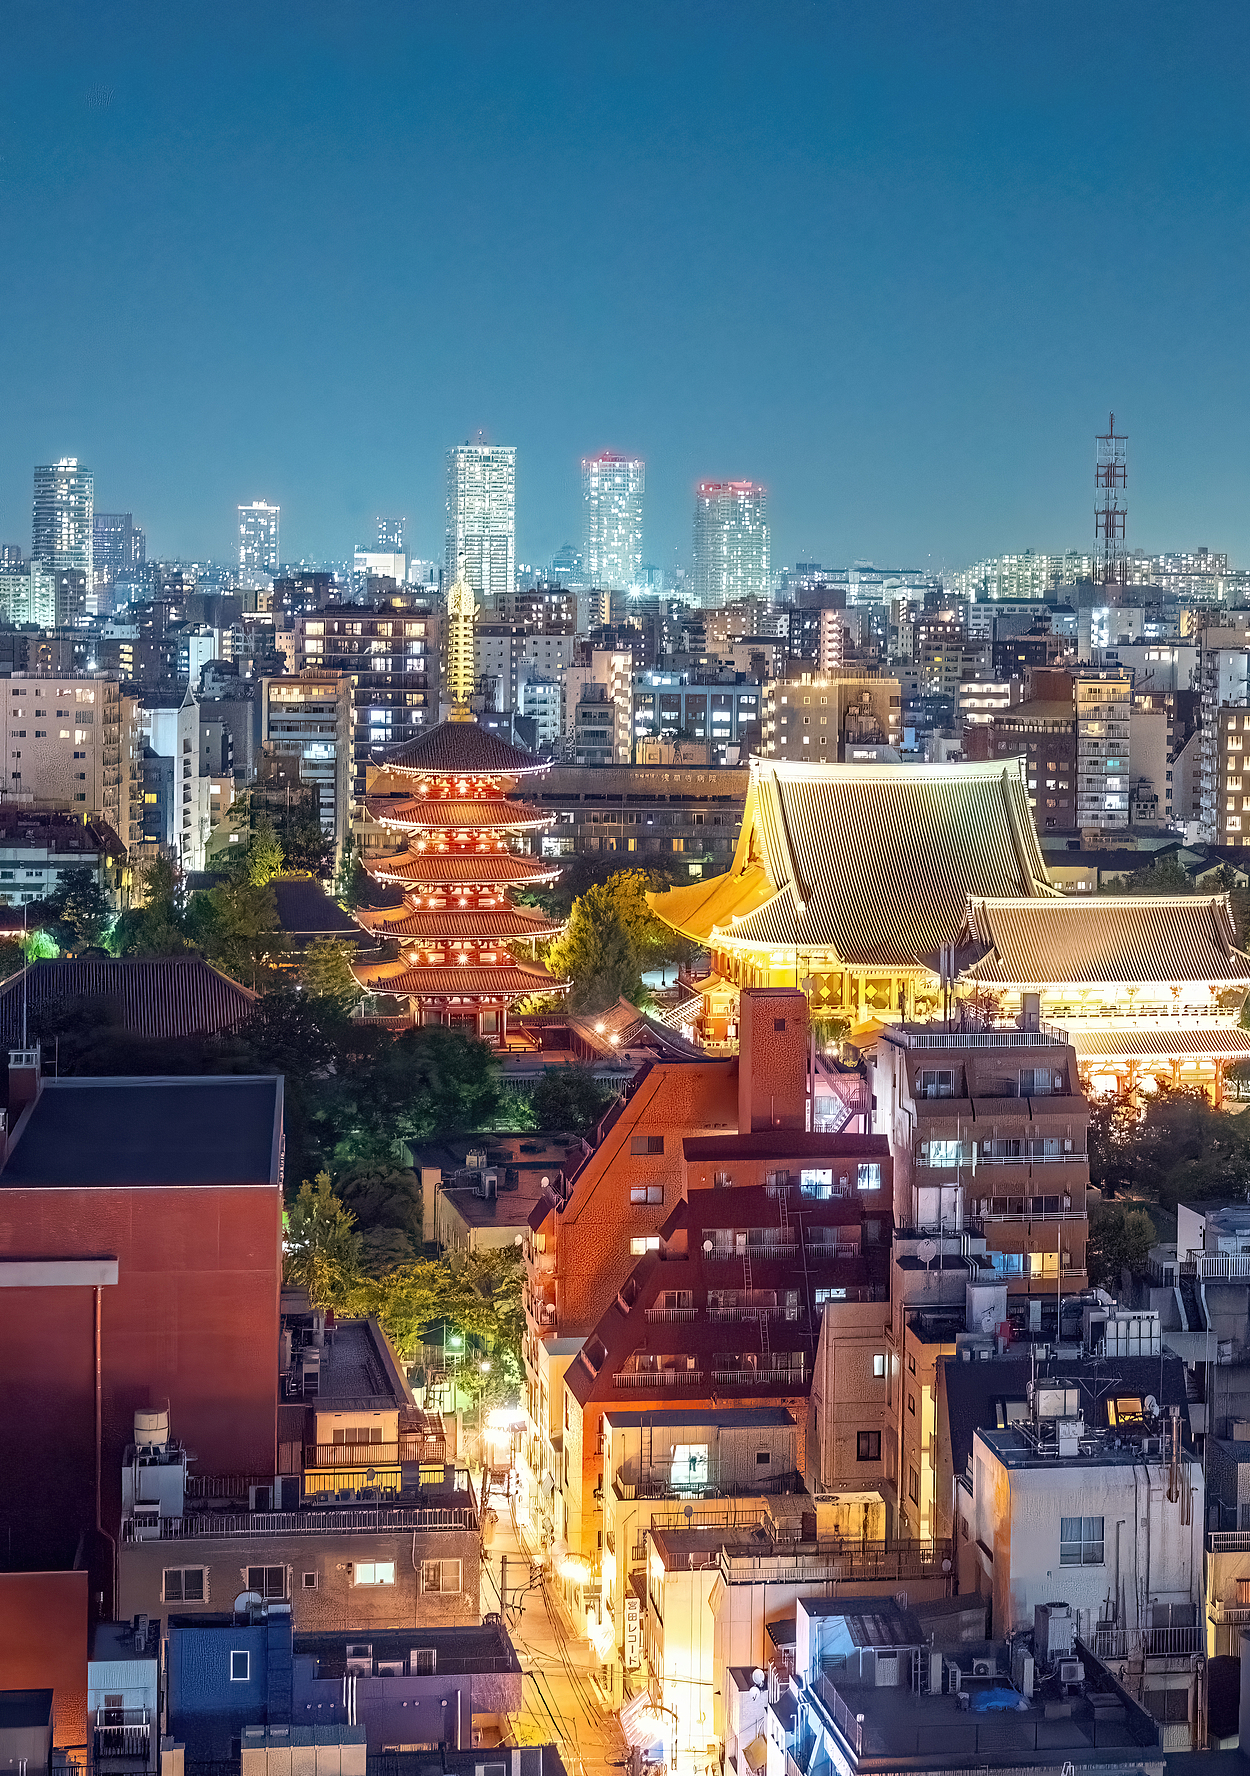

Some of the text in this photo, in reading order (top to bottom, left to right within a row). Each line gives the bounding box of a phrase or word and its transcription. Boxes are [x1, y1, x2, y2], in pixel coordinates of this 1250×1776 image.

[627, 1600, 638, 1666] 宮田レコード
